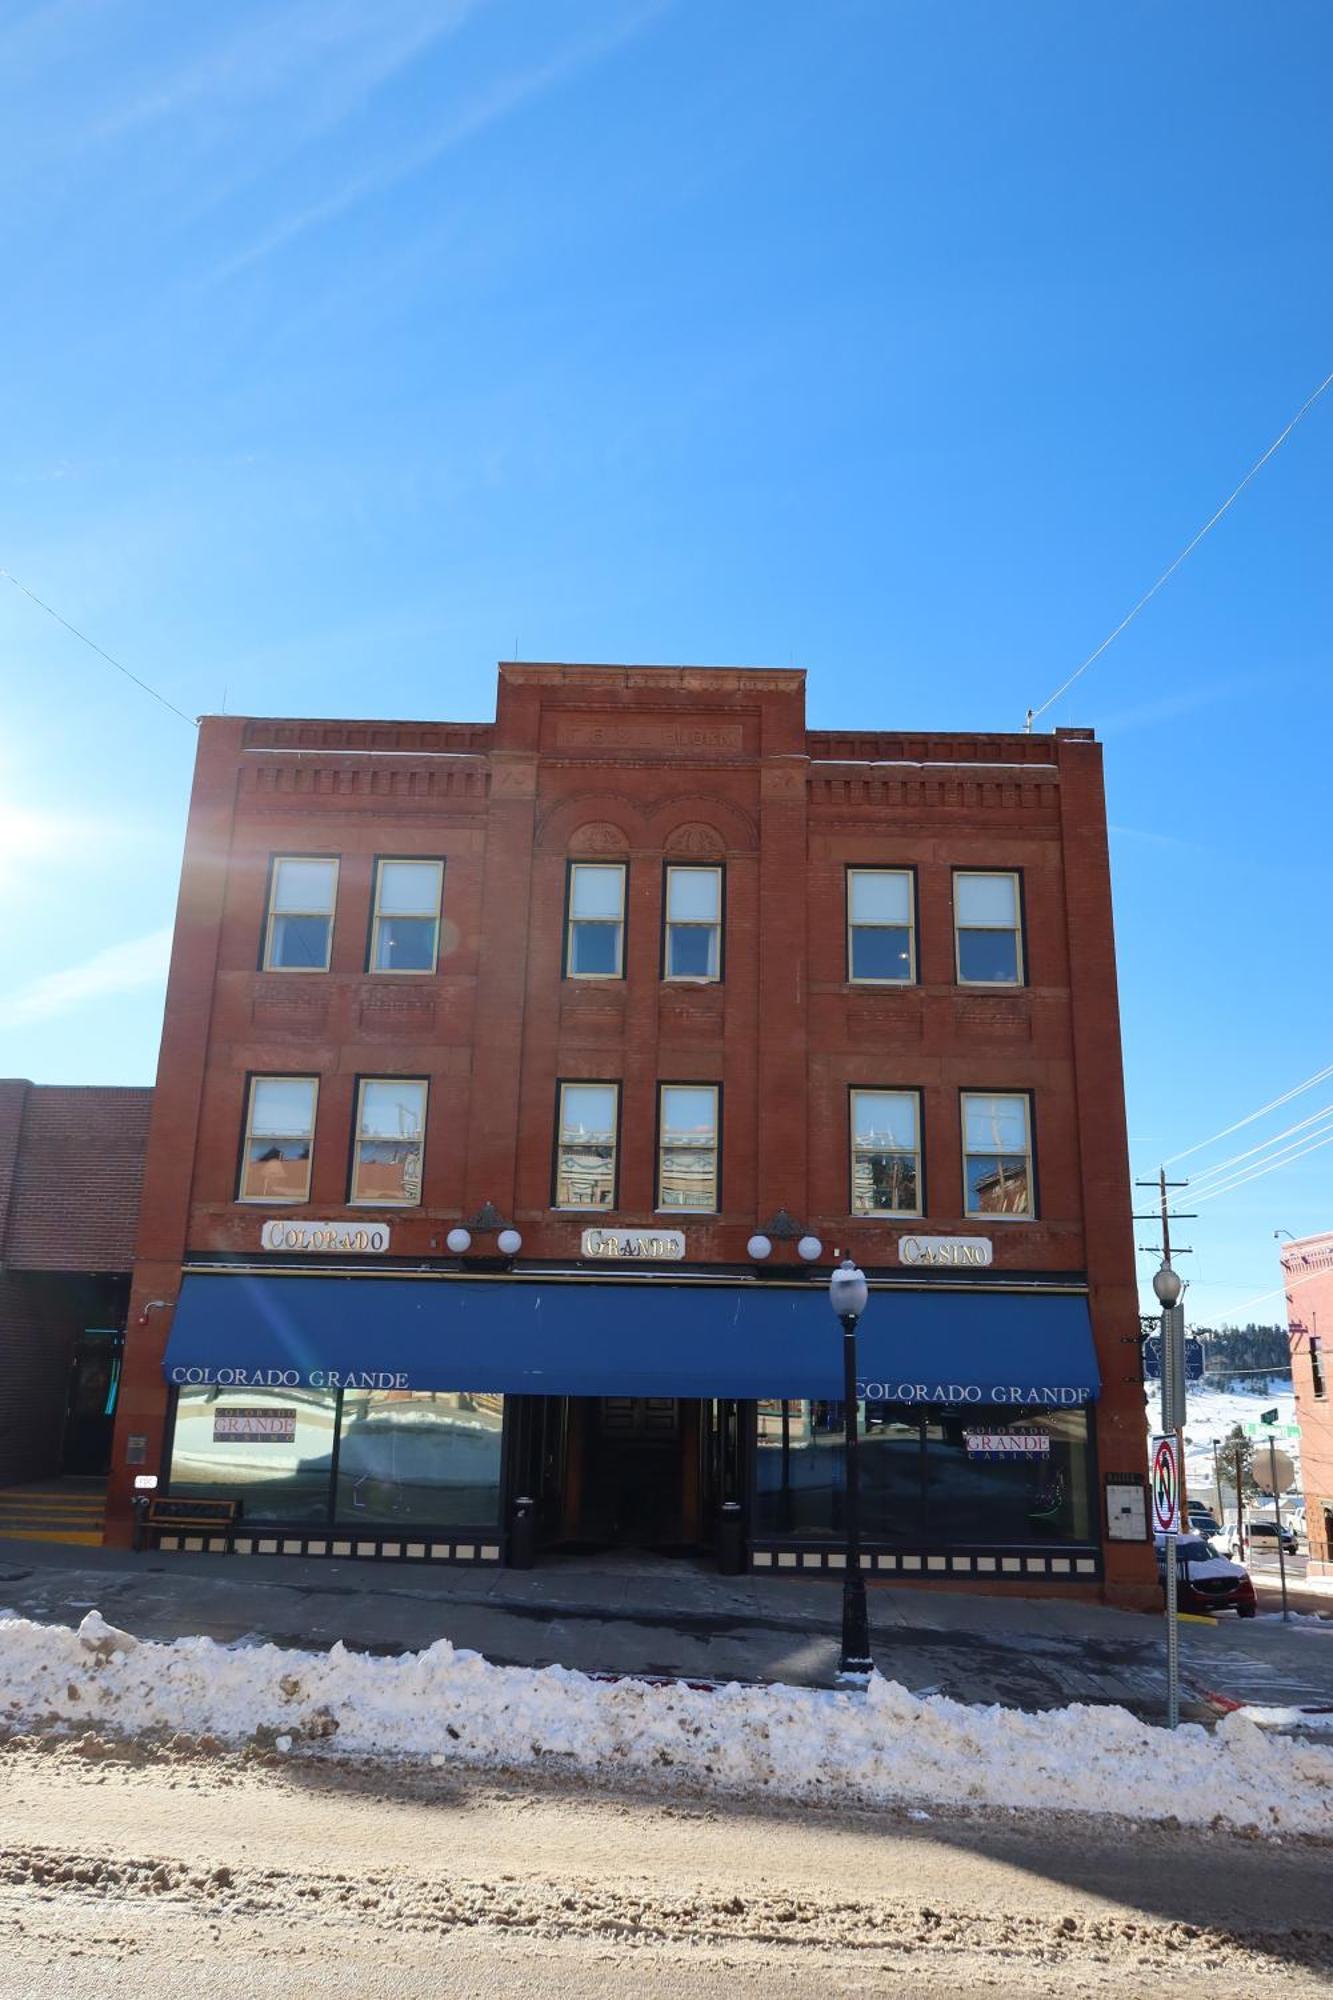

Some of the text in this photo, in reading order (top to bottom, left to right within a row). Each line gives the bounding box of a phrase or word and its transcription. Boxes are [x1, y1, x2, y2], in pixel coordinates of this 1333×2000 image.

[270, 1223, 383, 1250] COLORADO
[587, 1230, 679, 1257] GRANDE
[904, 1238, 987, 1265] CASINO
[172, 1367, 409, 1389] COLORADO GRANDE
[856, 1383, 1091, 1404] COLORADO GRANDE
[214, 1418, 295, 1433] GRANDE
[967, 1426, 1049, 1435] COLORADO
[967, 1436, 1049, 1450] GRANDE
[967, 1452, 1050, 1460] CASINO
